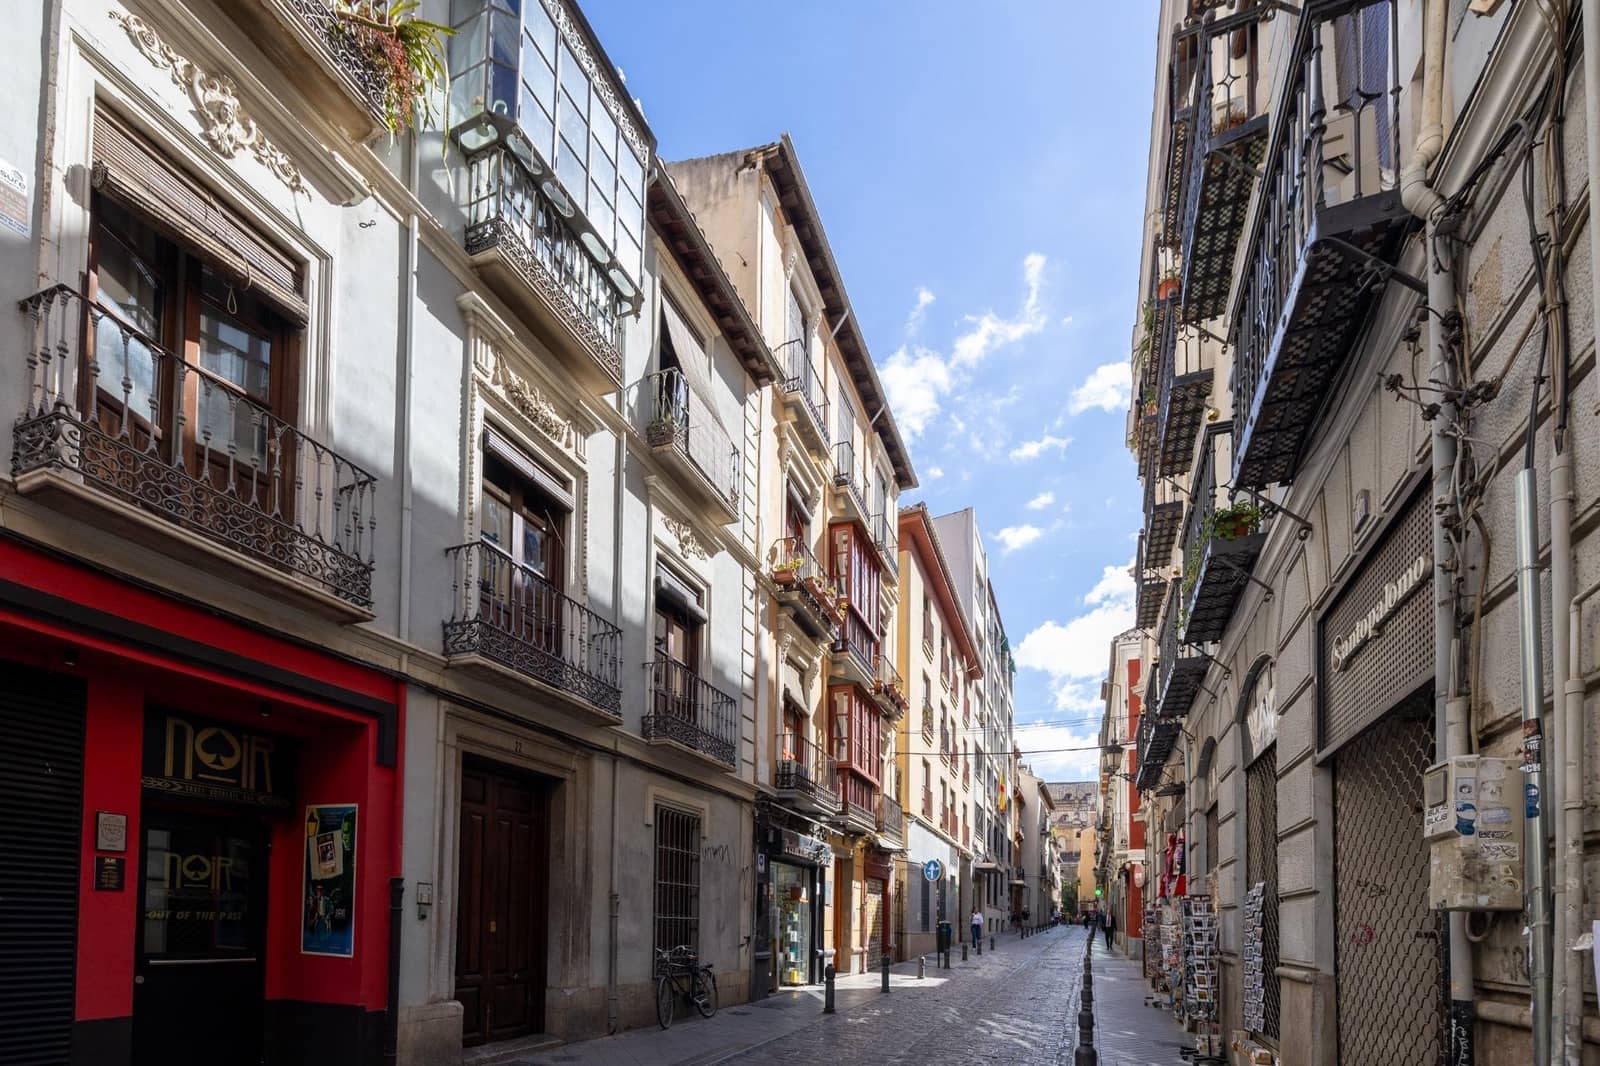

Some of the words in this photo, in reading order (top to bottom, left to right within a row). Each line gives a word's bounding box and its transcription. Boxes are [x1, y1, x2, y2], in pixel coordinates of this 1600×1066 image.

[1331, 556, 1426, 673] Santopalomo
[176, 911, 193, 921] OF
[196, 911, 216, 921] THE
[219, 911, 243, 921] PAST
